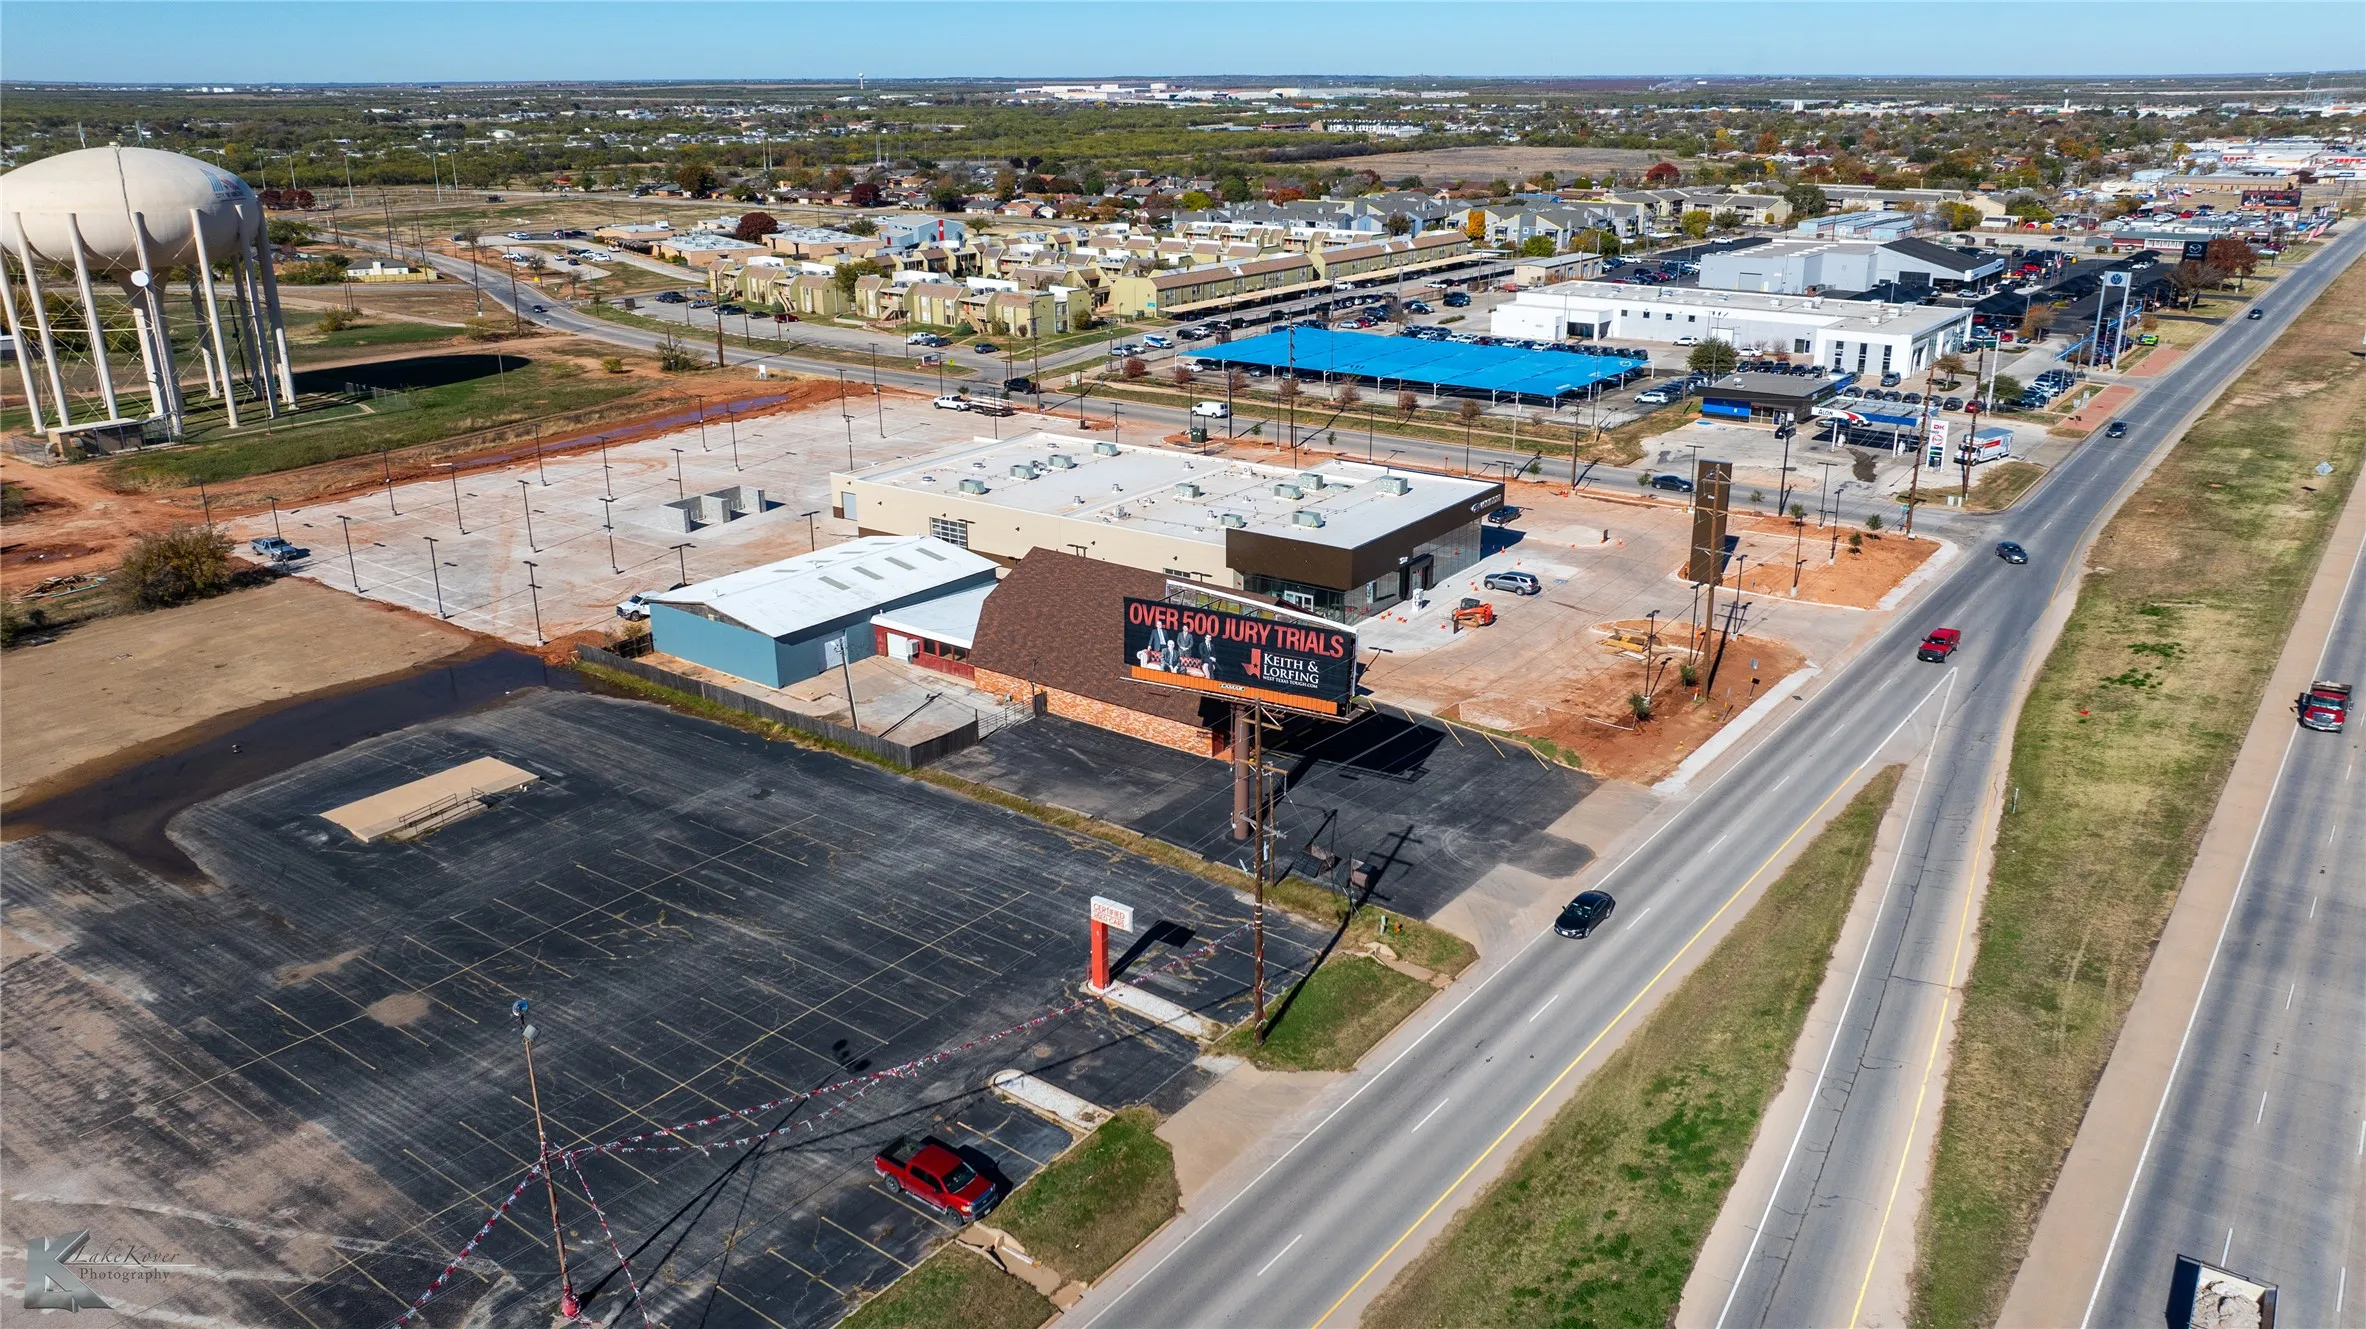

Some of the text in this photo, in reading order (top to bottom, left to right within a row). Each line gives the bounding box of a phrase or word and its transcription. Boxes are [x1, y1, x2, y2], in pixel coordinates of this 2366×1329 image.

[1817, 408, 1834, 416] ALON
[1129, 602, 1345, 658] OVER 500 JURY TRIALS
[1263, 653, 1320, 673] KEITH &
[1263, 664, 1320, 684] LORFING
[1094, 904, 1125, 919] CERTIFIED
